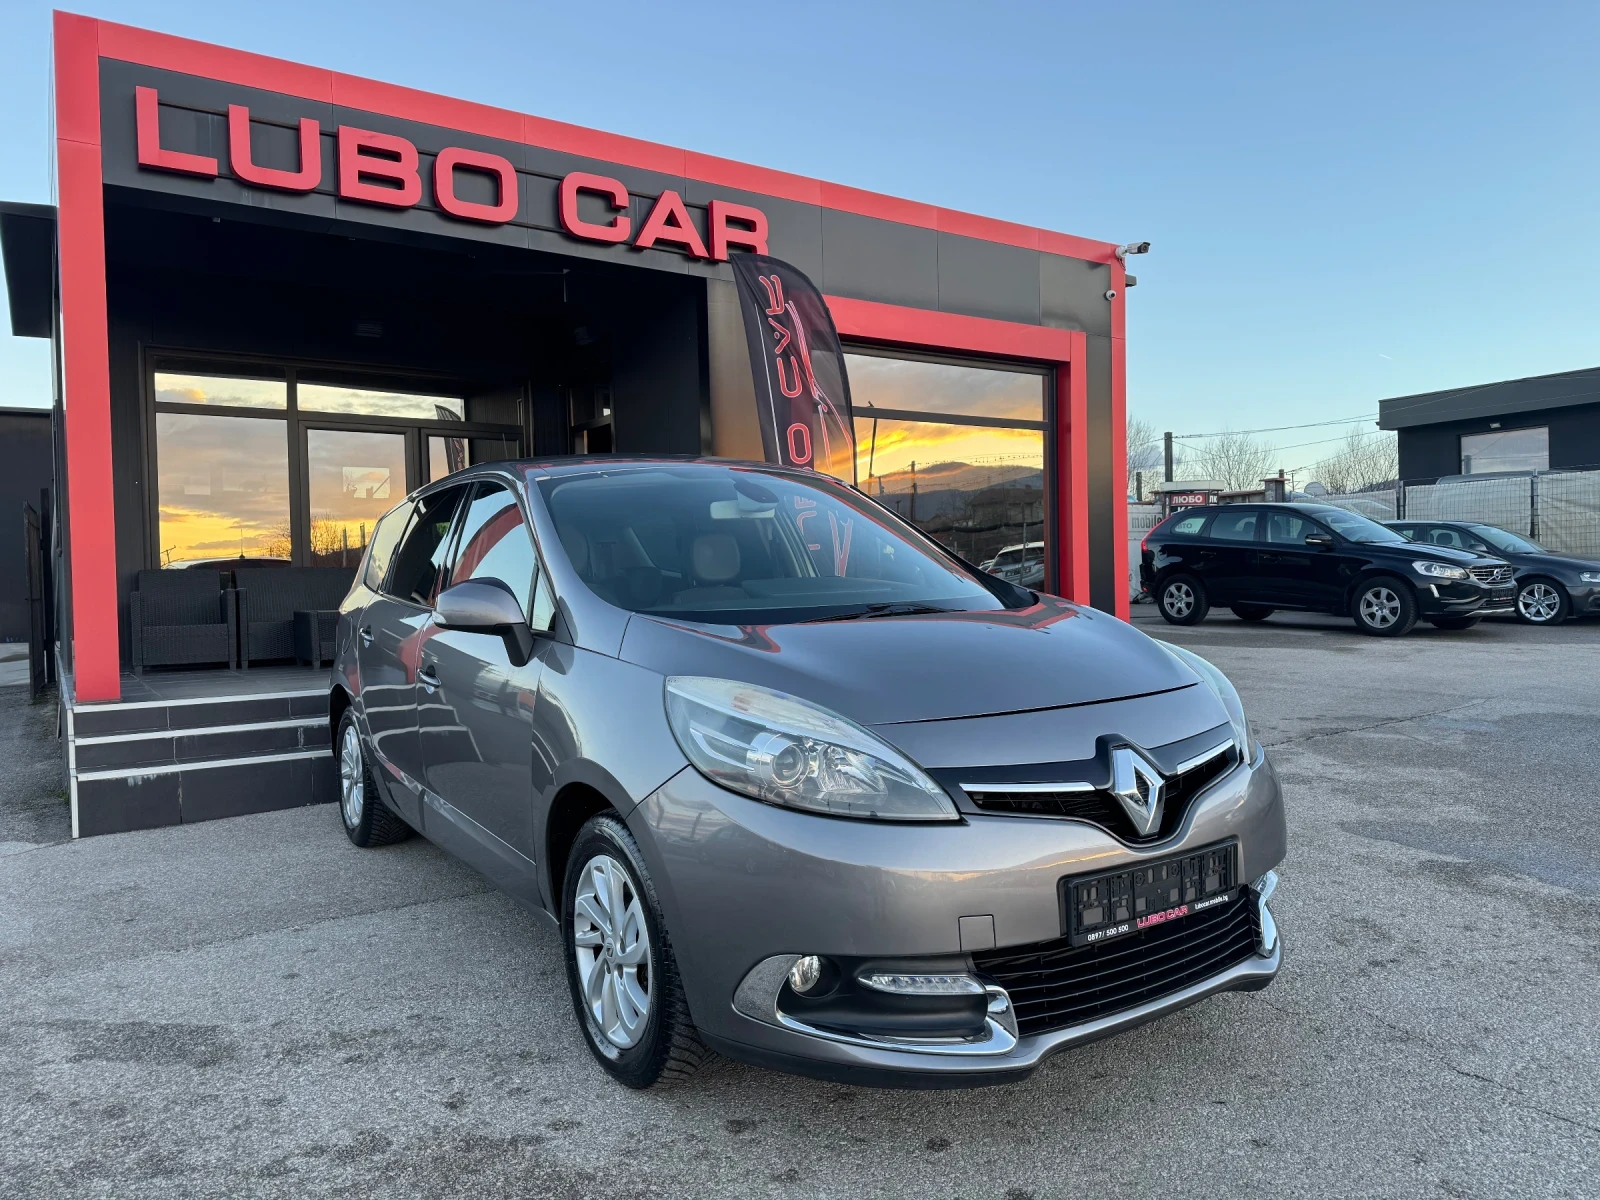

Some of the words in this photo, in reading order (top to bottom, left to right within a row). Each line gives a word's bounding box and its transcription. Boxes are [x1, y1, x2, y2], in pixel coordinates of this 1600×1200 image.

[135, 85, 520, 225] LUBO
[557, 170, 769, 261] CAR
[1173, 495, 1202, 504] ЛЮБО
[1136, 911, 1166, 928] LUBO
[1166, 904, 1189, 920] CAR
[1106, 927, 1117, 937] 500
[1118, 924, 1129, 933] 500
